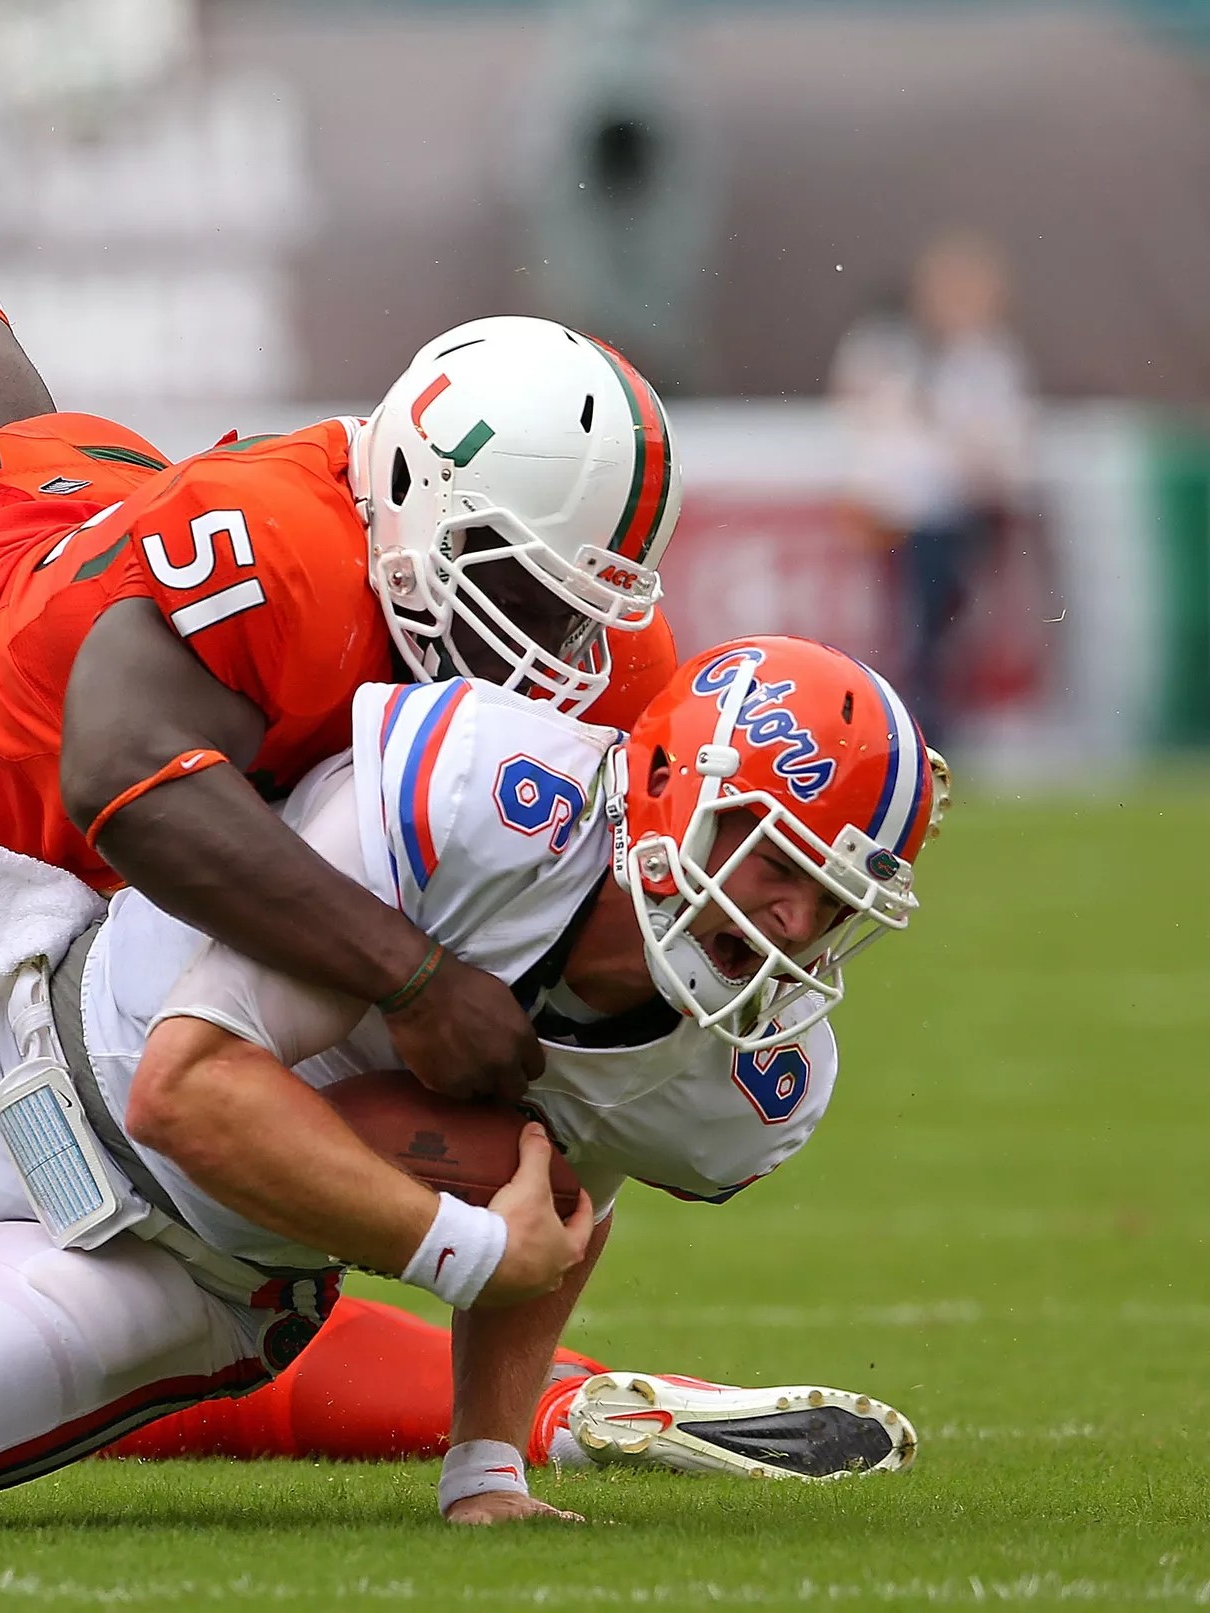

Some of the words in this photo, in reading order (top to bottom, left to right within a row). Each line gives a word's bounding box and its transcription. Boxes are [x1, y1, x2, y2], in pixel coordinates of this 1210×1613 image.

[141, 508, 267, 638] 51
[596, 564, 639, 590] ACC
[731, 1016, 811, 1125] 6
